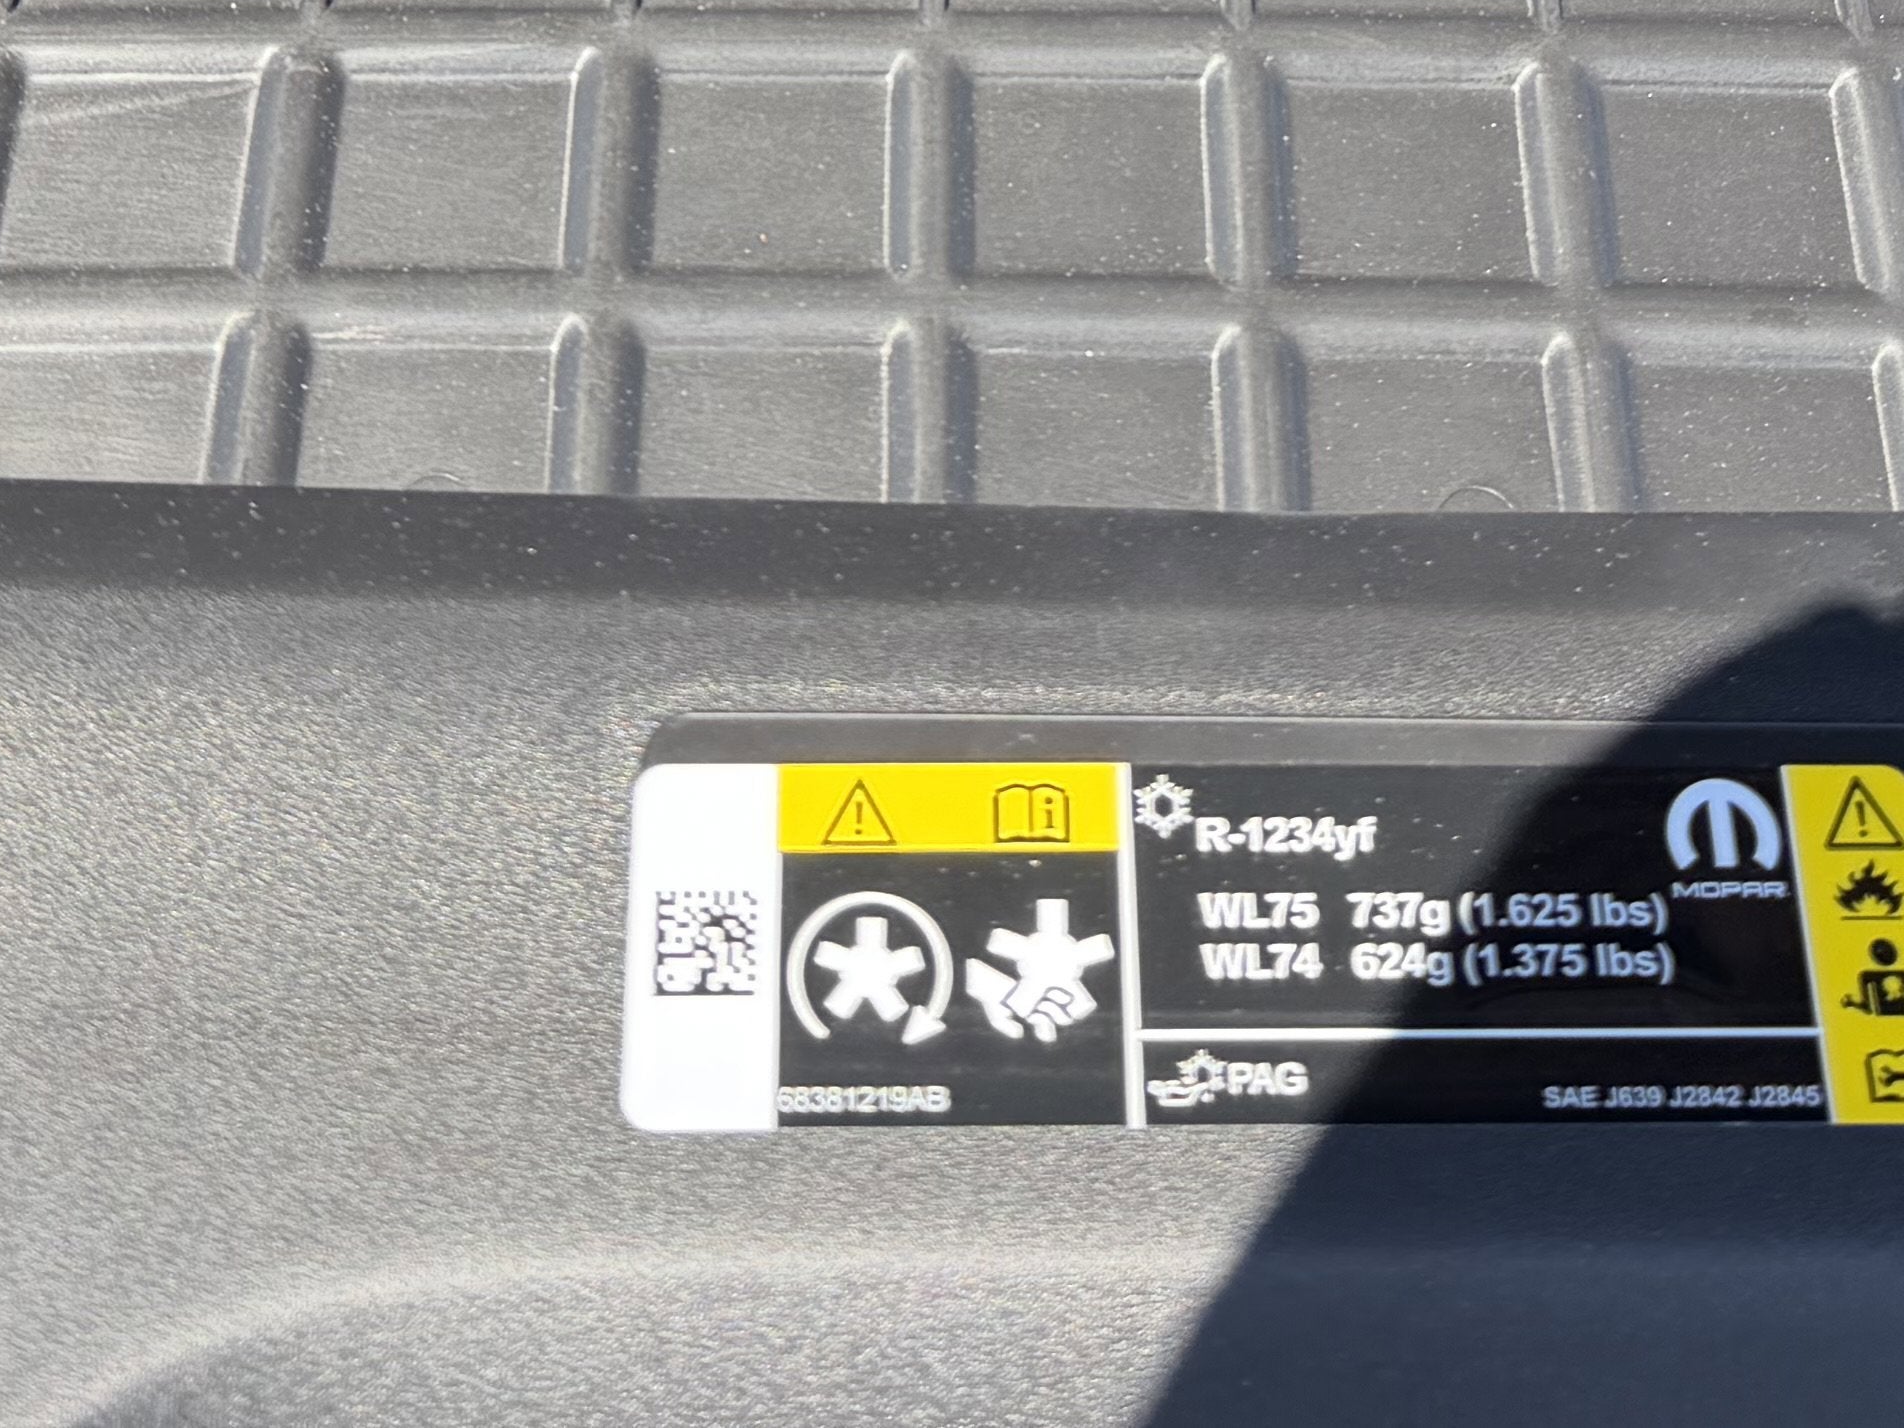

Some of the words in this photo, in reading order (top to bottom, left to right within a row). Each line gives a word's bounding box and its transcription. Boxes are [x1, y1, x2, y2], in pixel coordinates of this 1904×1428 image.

[1195, 816, 1378, 861] R-1234yf
[1669, 880, 1790, 900] MOPAR
[1199, 892, 1321, 930] WL75
[1350, 892, 1449, 937] 737g
[1458, 890, 1583, 936] (1.625
[1589, 890, 1669, 936] lbs)
[1199, 944, 1323, 981] WL74
[1350, 944, 1453, 987] 624g
[1464, 942, 1590, 986] (1.375
[1595, 942, 1676, 986] lbs)
[1227, 1061, 1307, 1098] PAG
[1542, 1085, 1598, 1109] SAE
[1603, 1085, 1662, 1109] J639
[1668, 1085, 1741, 1109] J2842
[1747, 1084, 1822, 1108] J2845
[776, 1085, 953, 1114] 68381219AB
